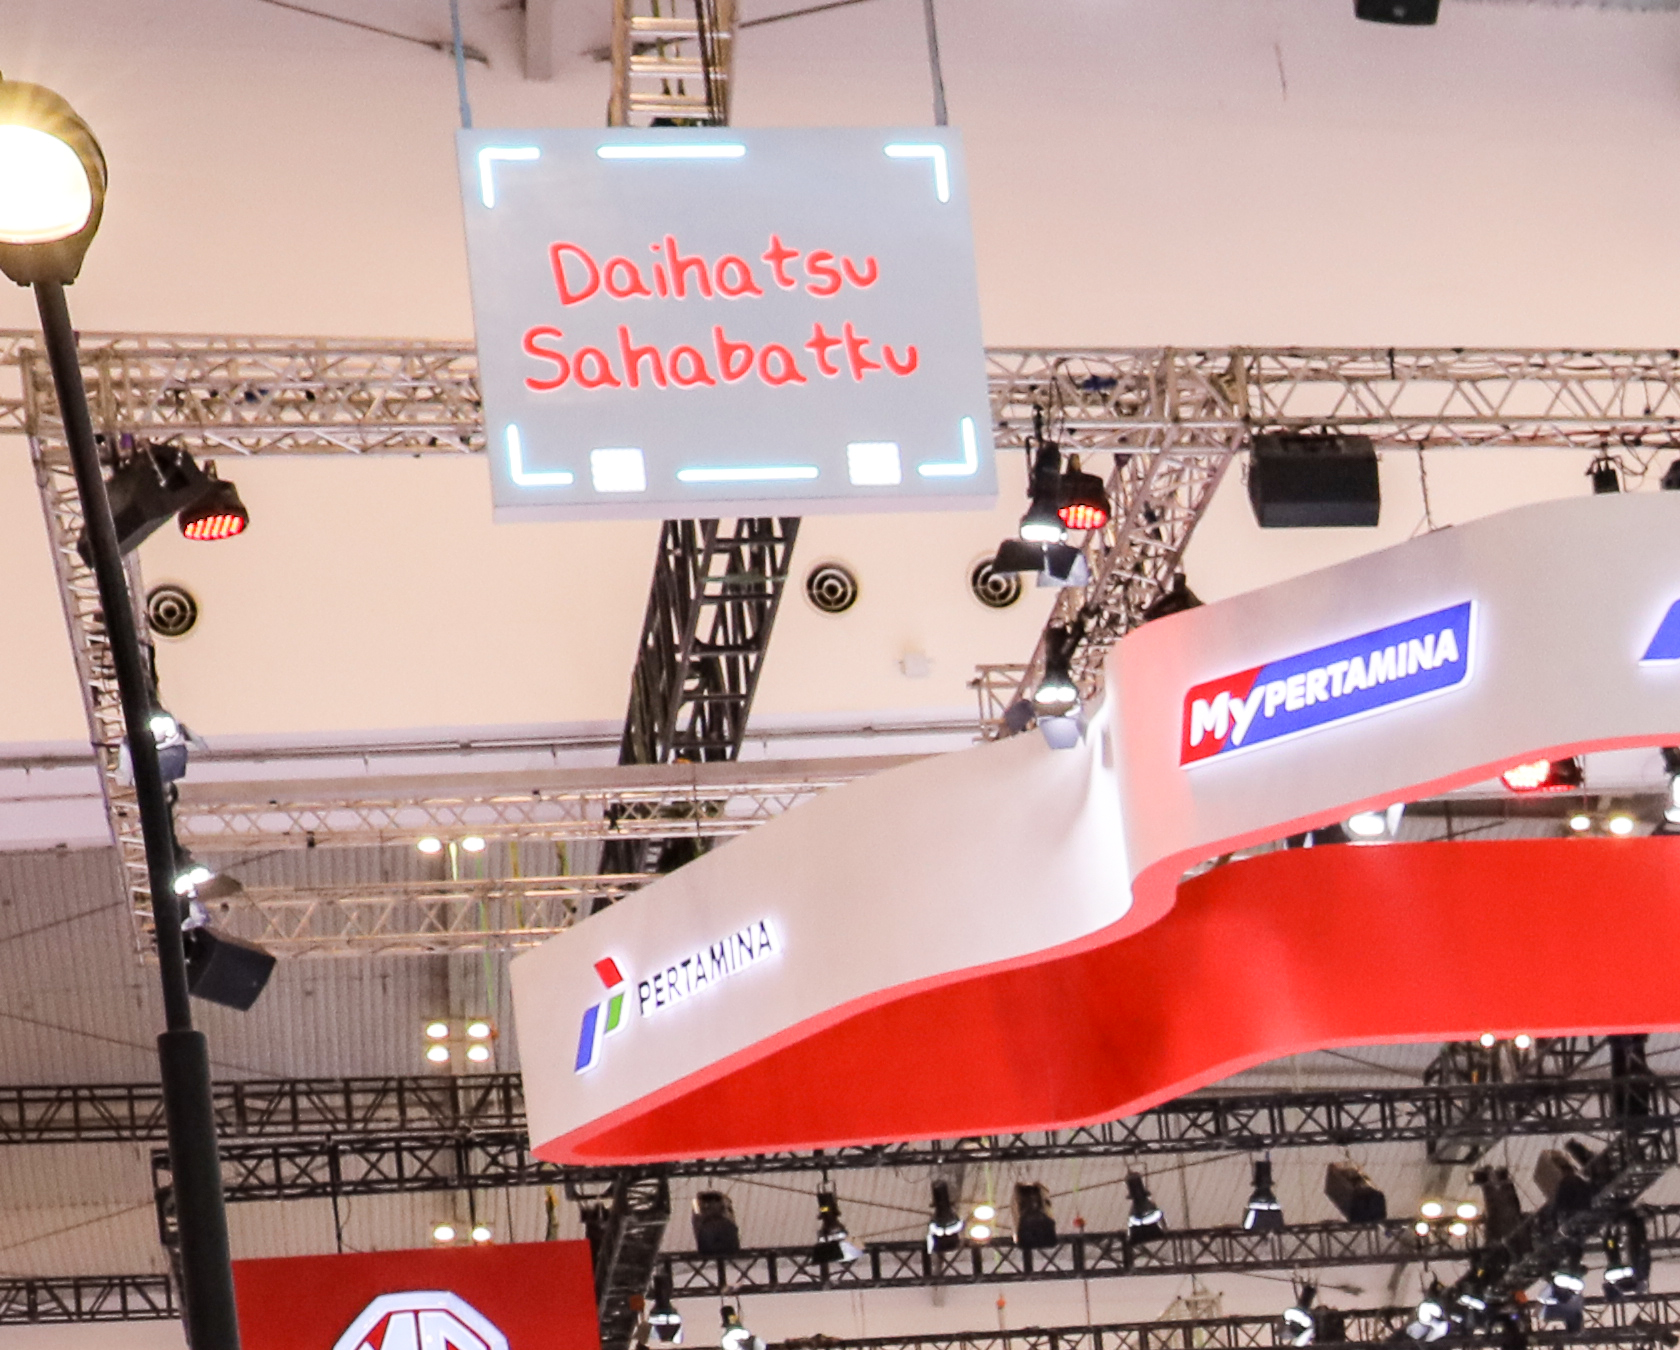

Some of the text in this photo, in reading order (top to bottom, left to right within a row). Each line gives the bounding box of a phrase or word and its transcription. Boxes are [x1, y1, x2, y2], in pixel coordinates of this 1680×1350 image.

[547, 233, 879, 306] Daihatsu
[522, 321, 919, 392] Sahabatku
[637, 919, 776, 1016] PERTAMINA
